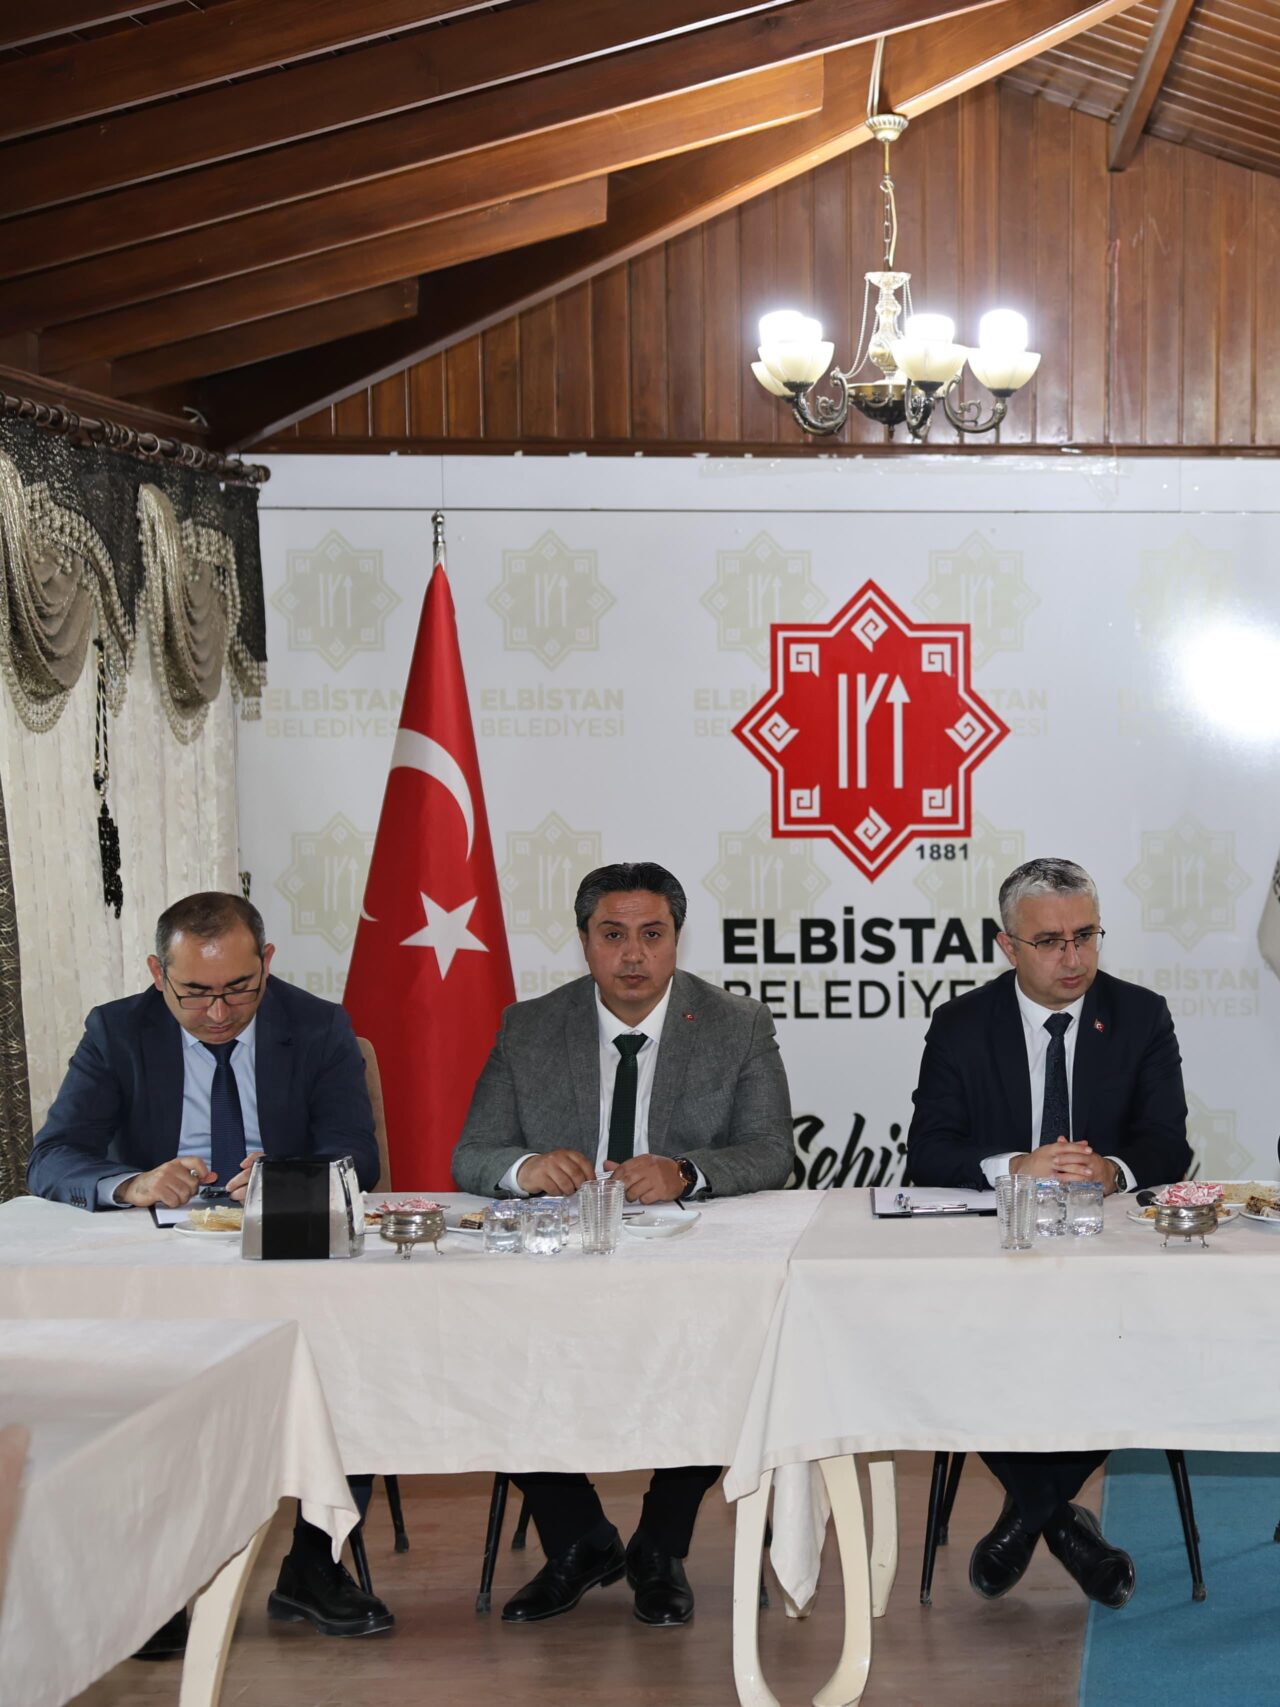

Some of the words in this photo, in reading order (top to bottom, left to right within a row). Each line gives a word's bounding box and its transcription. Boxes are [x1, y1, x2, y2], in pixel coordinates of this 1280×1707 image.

[479, 683, 624, 711] ELBİSTAN
[265, 713, 400, 738] BELEDİYES
[479, 713, 625, 738] BELEDİYESİ
[915, 843, 968, 861] 1881
